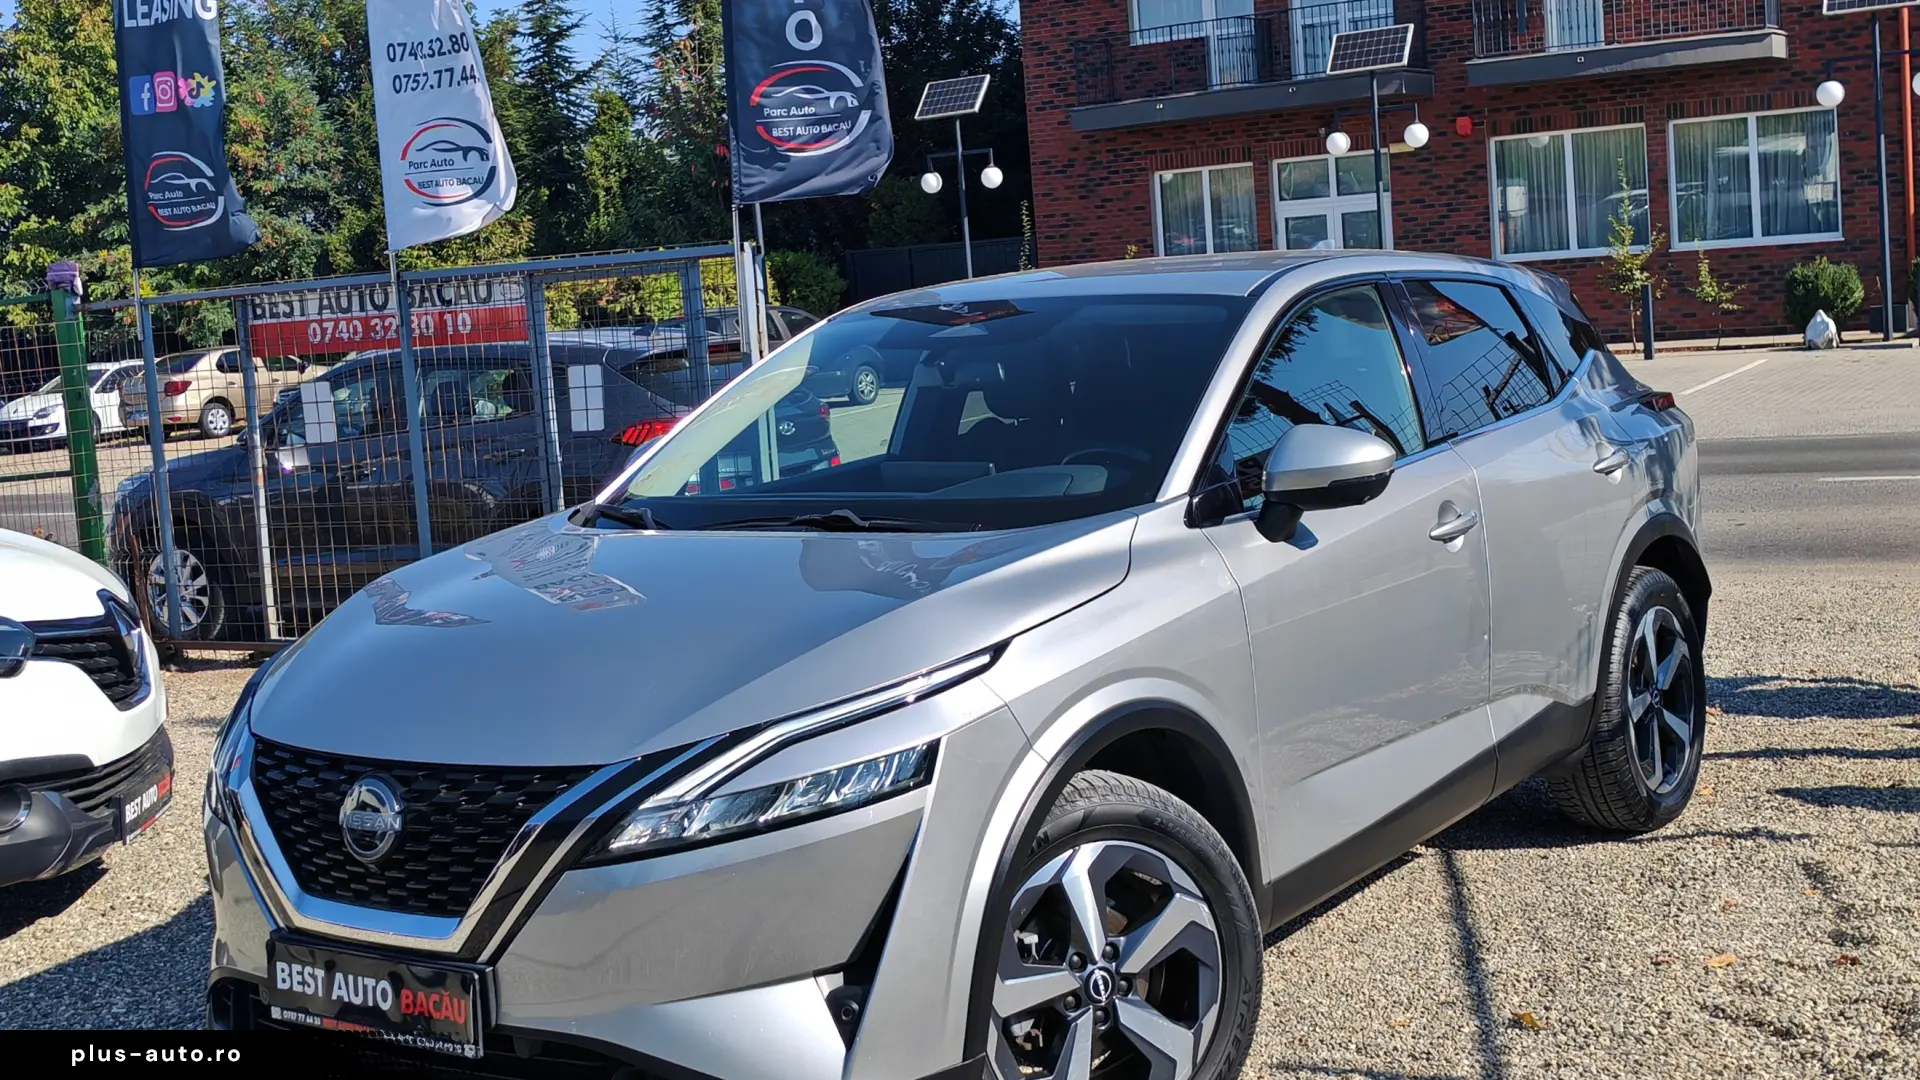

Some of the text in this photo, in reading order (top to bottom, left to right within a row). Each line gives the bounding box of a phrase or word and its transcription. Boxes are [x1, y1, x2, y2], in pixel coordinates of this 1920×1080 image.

[123, 0, 218, 27] LEASING
[763, 106, 816, 117] Parc Auto
[772, 120, 851, 137] BEST AUTO BACAU
[408, 158, 455, 171] Parc Auto
[417, 176, 484, 189] BEST AUTO BACAU
[165, 190, 184, 199] Auto
[173, 205, 192, 214] AUTO
[251, 292, 306, 320] BEST
[318, 286, 390, 315] AUTO
[308, 320, 363, 344] 0740
[370, 317, 397, 340] 32
[443, 311, 472, 335] 10
[125, 796, 142, 823] BEST
[142, 784, 158, 812] AUTO
[276, 961, 325, 997] BEST
[331, 972, 393, 1011] AUTO
[400, 987, 467, 1025] BACĂU
